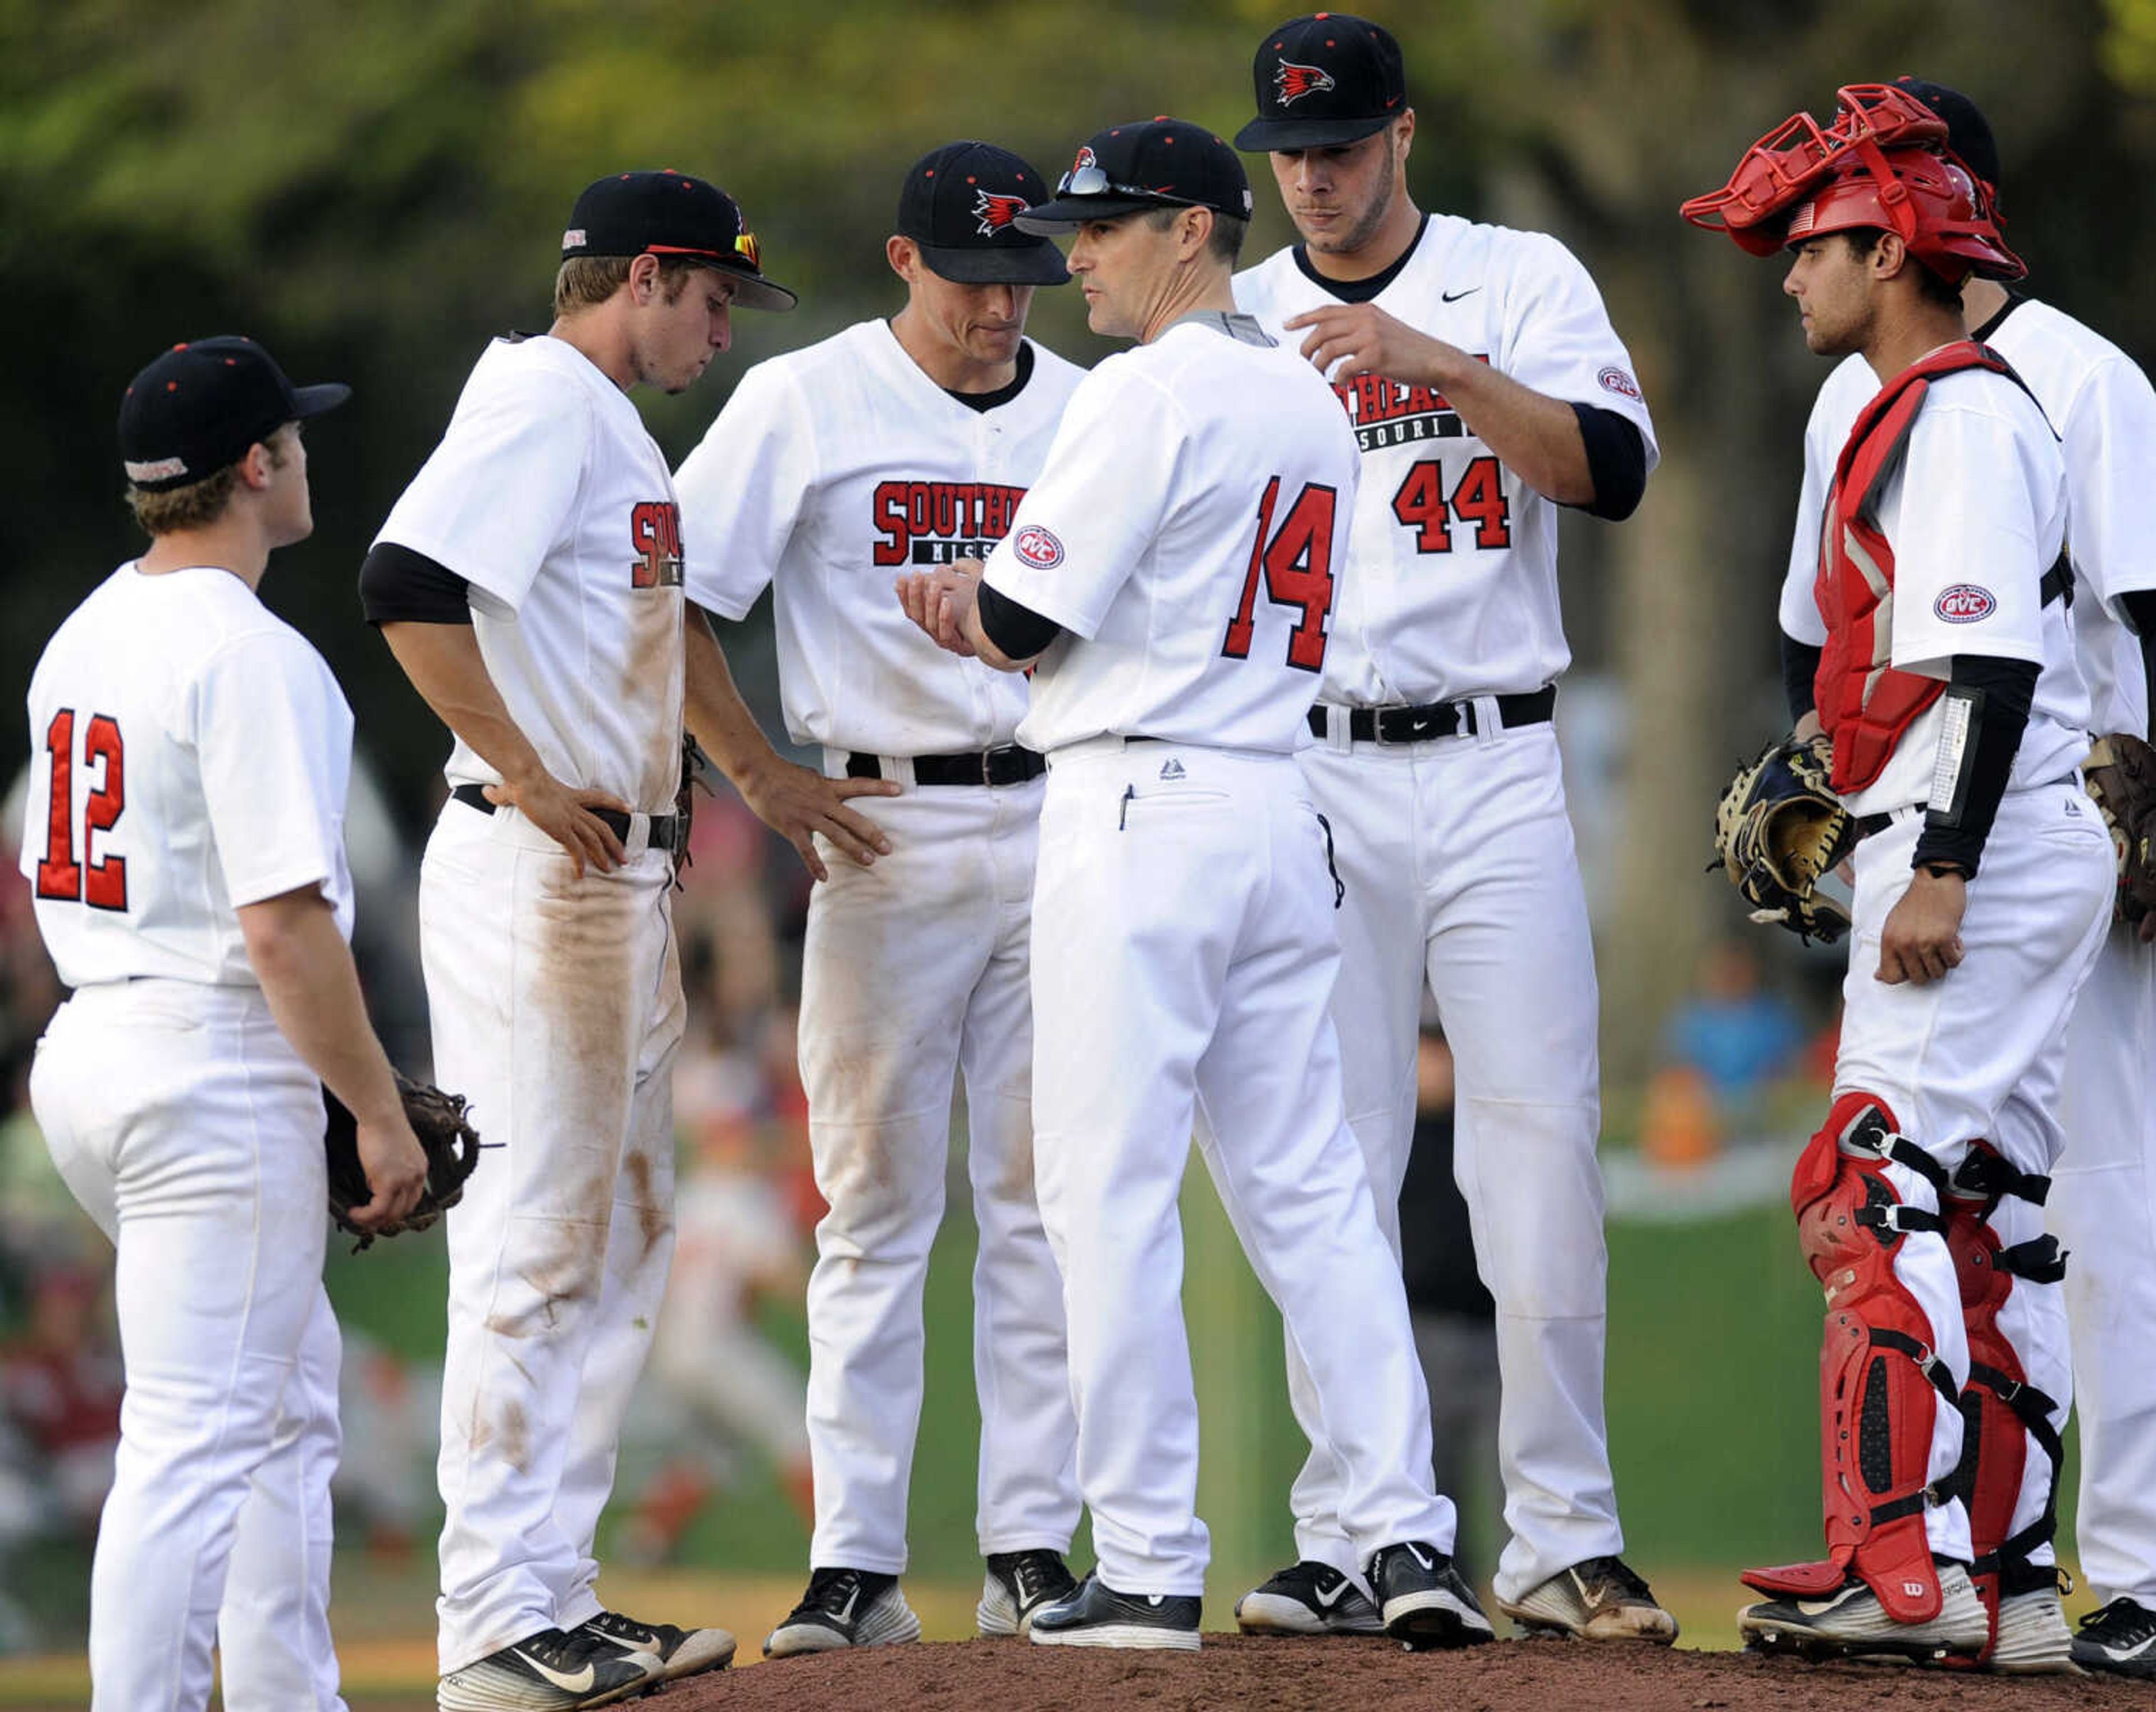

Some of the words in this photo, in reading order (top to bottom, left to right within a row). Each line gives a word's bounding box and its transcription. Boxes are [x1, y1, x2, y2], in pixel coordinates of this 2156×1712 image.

[873, 481, 1029, 566] SOUTH
[1221, 475, 1337, 674] 14
[1391, 456, 1511, 555] 44
[36, 708, 128, 913] 12
